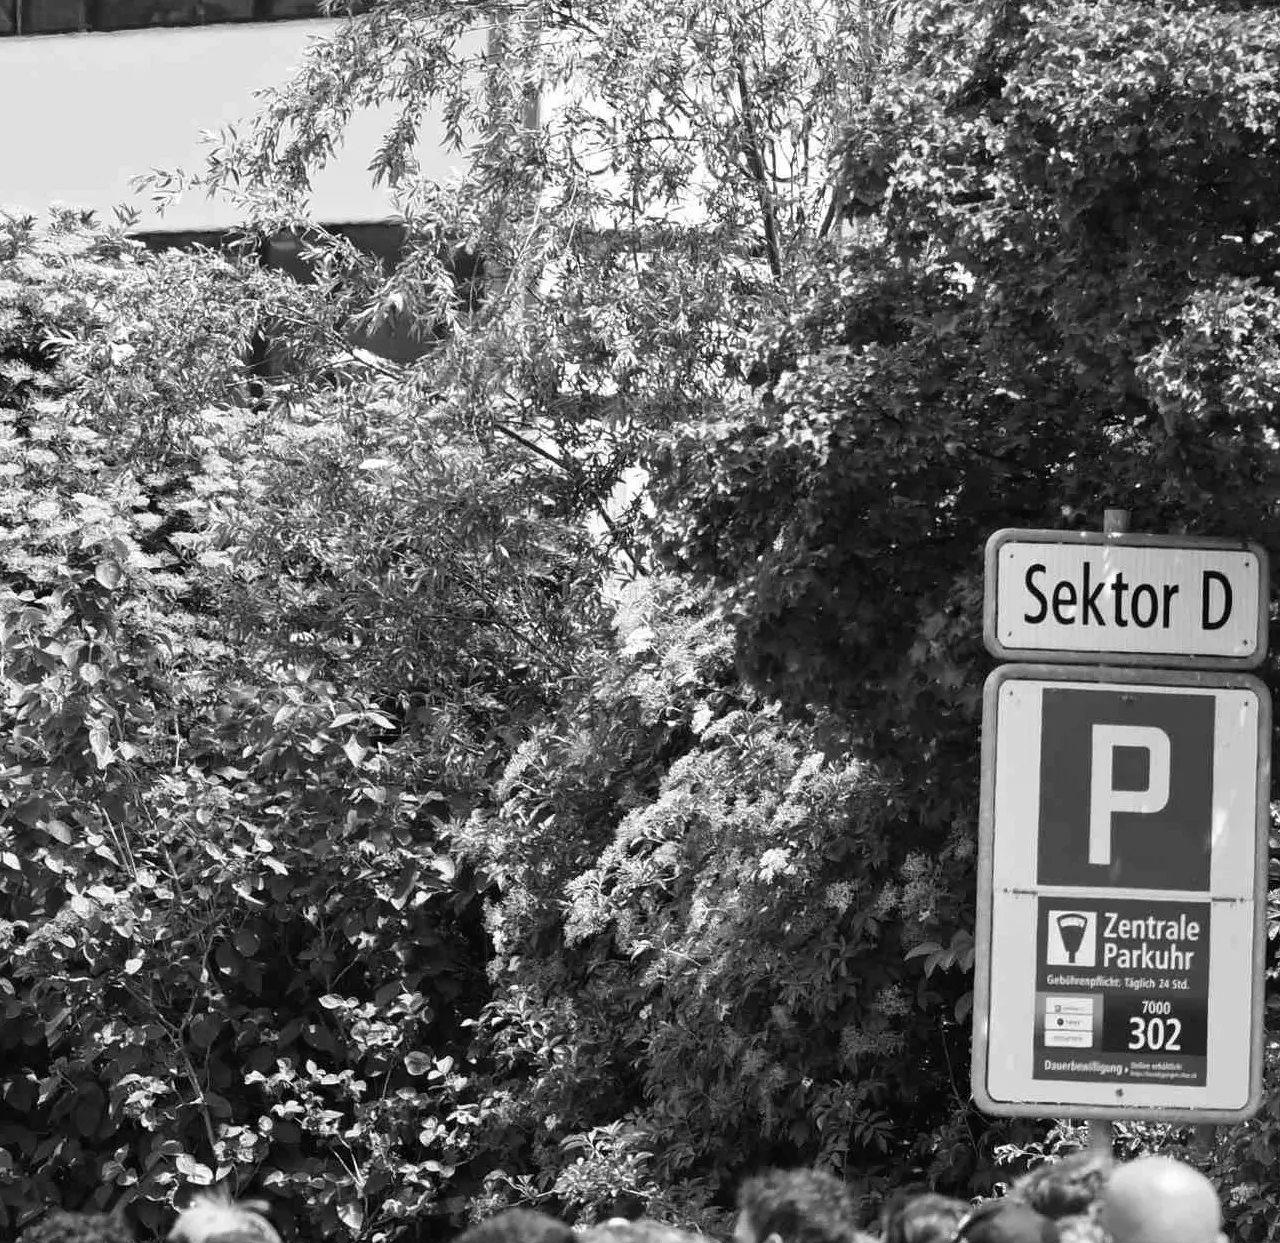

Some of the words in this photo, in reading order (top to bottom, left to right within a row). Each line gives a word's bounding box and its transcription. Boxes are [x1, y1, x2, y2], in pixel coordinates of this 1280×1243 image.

[1024, 561, 1180, 629] Sektor
[1202, 570, 1233, 631] D
[1089, 724, 1171, 866] P
[1103, 911, 1200, 941] Zentrale
[1103, 942, 1195, 970] Parkuhr
[1124, 977, 1156, 990] Täglich
[1159, 979, 1169, 989] 24
[1172, 979, 1191, 990] Std.
[1141, 1001, 1171, 1015] 7000
[1128, 1016, 1182, 1051] 302
